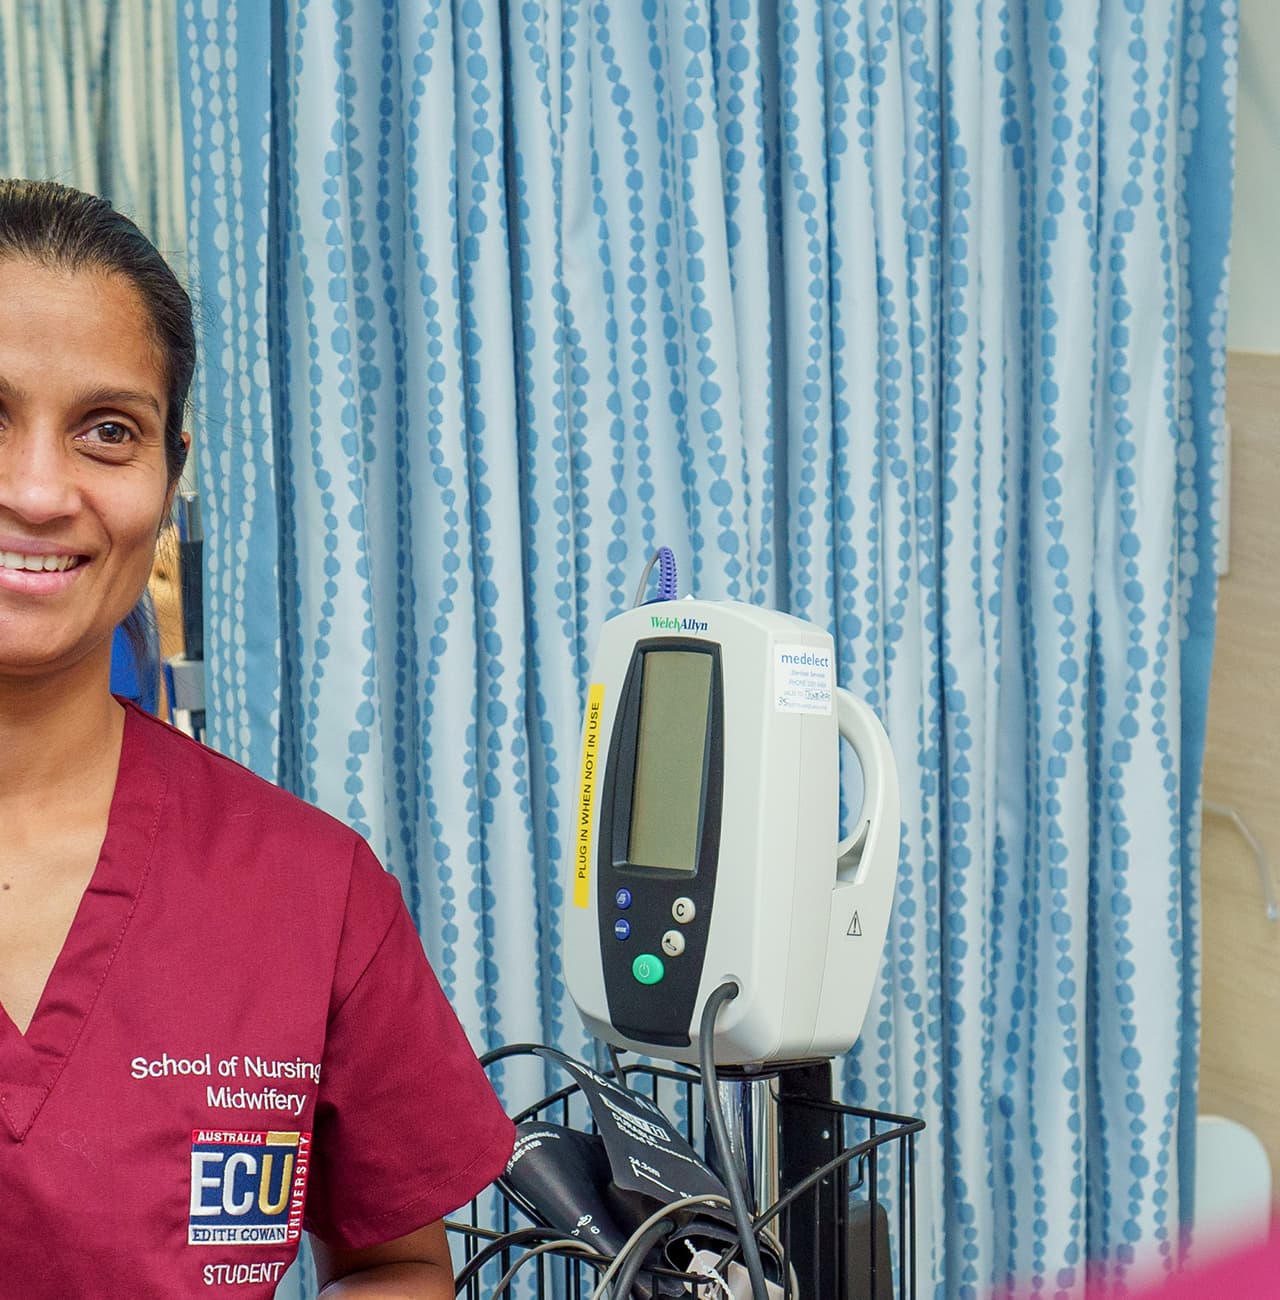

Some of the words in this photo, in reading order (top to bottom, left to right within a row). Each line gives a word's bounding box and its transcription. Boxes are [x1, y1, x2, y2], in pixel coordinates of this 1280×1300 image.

[781, 652, 829, 667] medelect
[590, 702, 600, 730] USE
[588, 734, 596, 748] IN
[585, 752, 594, 781] NOT
[582, 784, 591, 825] WHEN
[580, 828, 589, 841] IN
[578, 844, 588, 879] PLUG
[676, 903, 685, 917] C
[130, 1053, 211, 1079] School
[218, 1056, 239, 1077] of
[245, 1056, 321, 1084] Nursing
[206, 1086, 307, 1116] Midwifery
[197, 1131, 262, 1143] AUSTRALIA
[190, 1151, 294, 1216] ECU
[288, 1136, 310, 1239] UNIVERSITY
[192, 1228, 238, 1242] EDITH
[240, 1227, 286, 1241] COWAN
[203, 1262, 285, 1285] STUDENT
